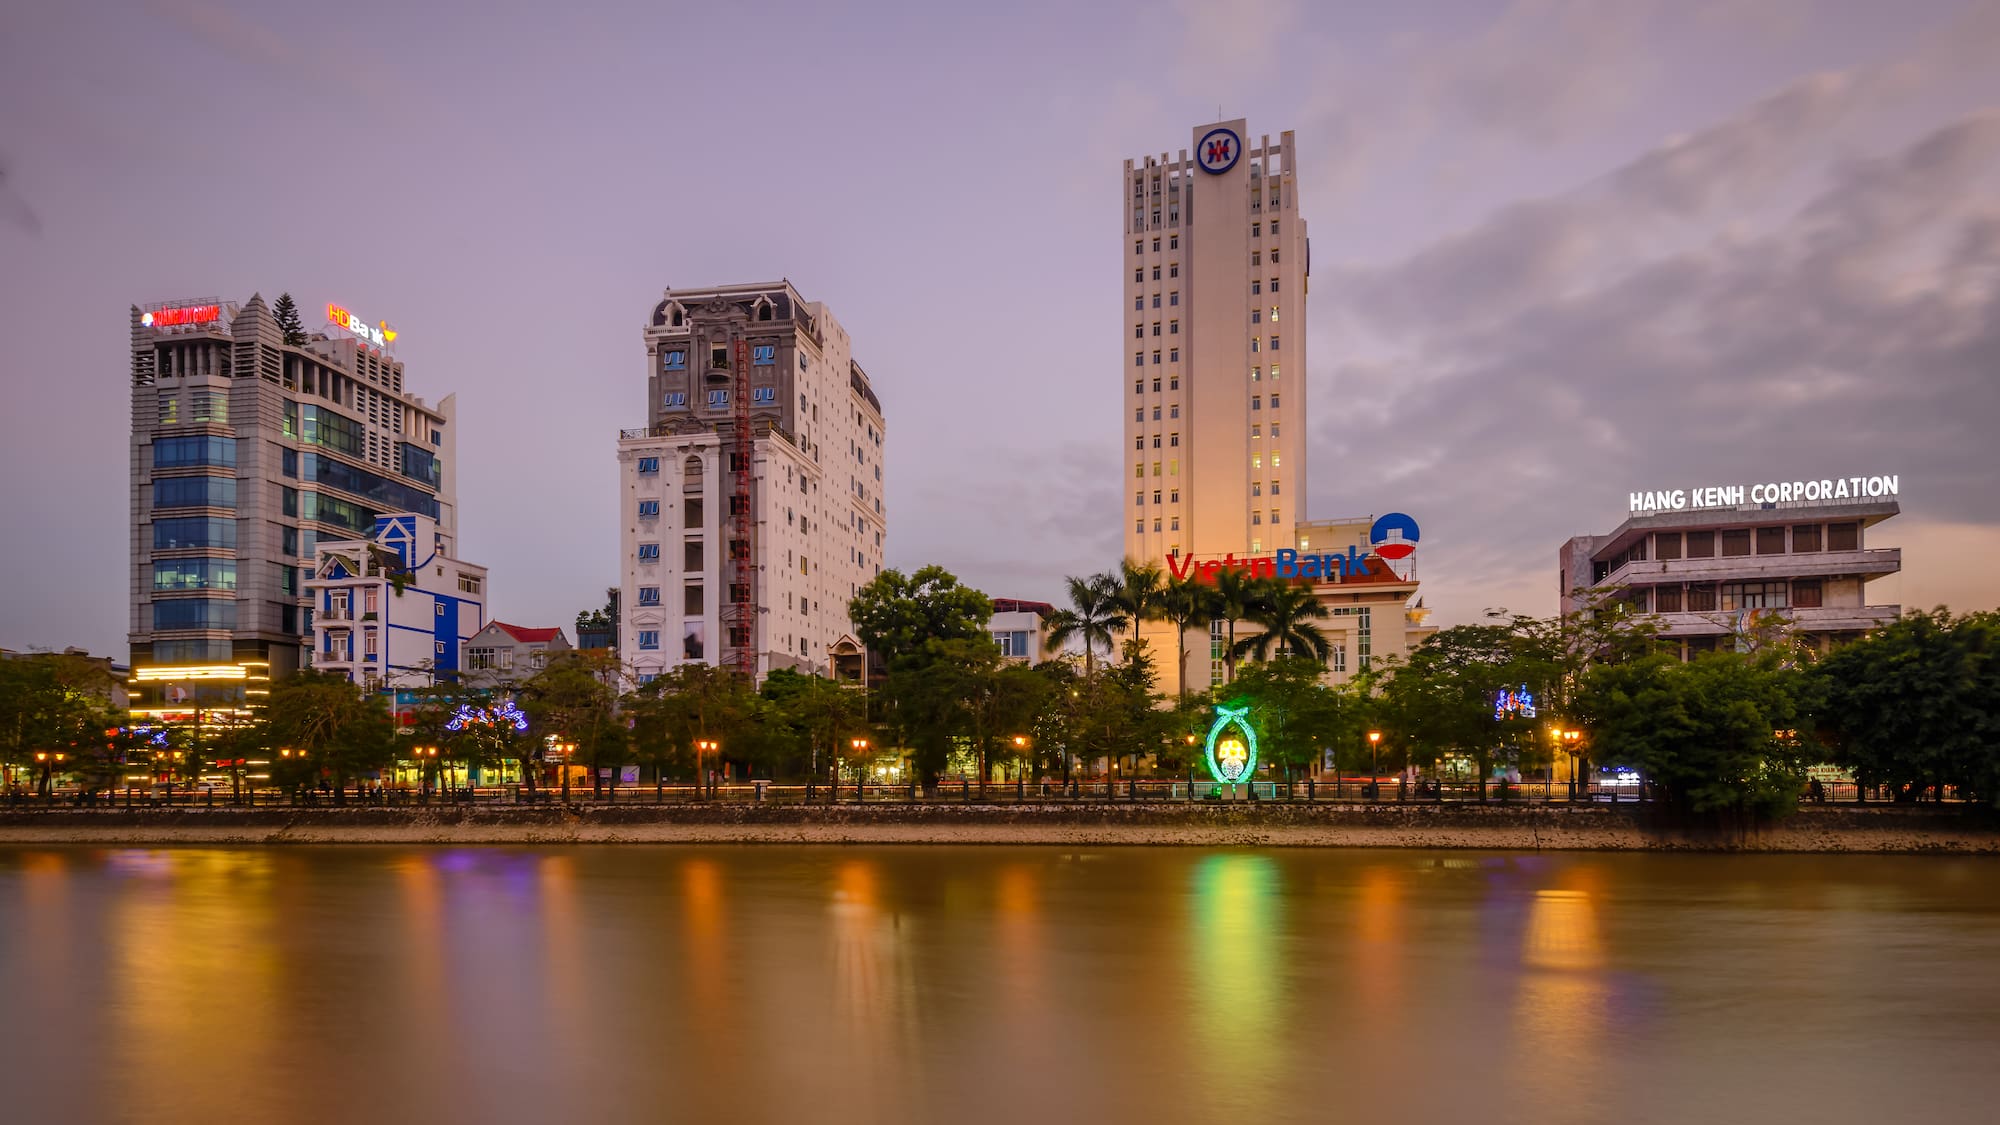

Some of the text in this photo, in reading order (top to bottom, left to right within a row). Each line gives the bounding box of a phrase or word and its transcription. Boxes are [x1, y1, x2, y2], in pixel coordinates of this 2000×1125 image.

[1630, 475, 1899, 512] HANG KENH CORPORATION
